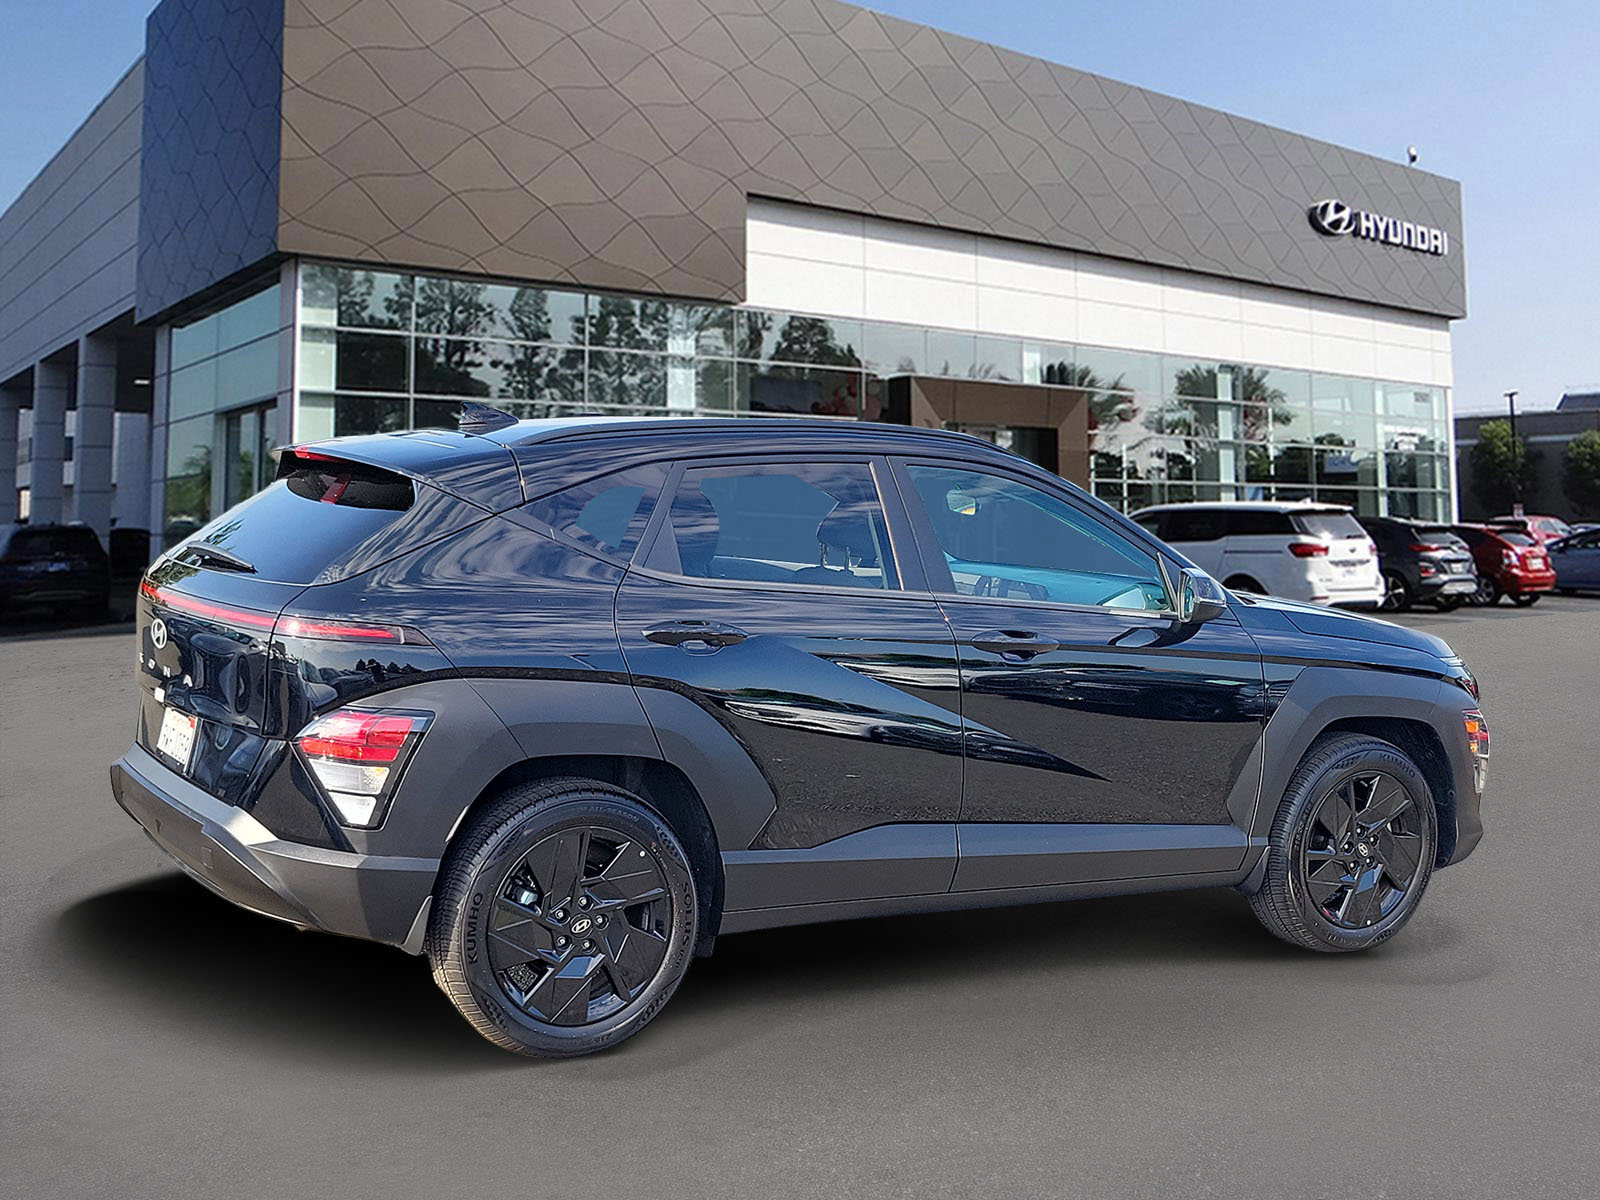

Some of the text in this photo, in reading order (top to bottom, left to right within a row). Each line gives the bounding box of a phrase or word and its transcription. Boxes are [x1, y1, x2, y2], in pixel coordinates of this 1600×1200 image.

[1360, 211, 1448, 255] HYUNDAI
[139, 652, 193, 688] KONA
[1380, 753, 1416, 778] KUMHO
[467, 892, 484, 965] KUMHO
